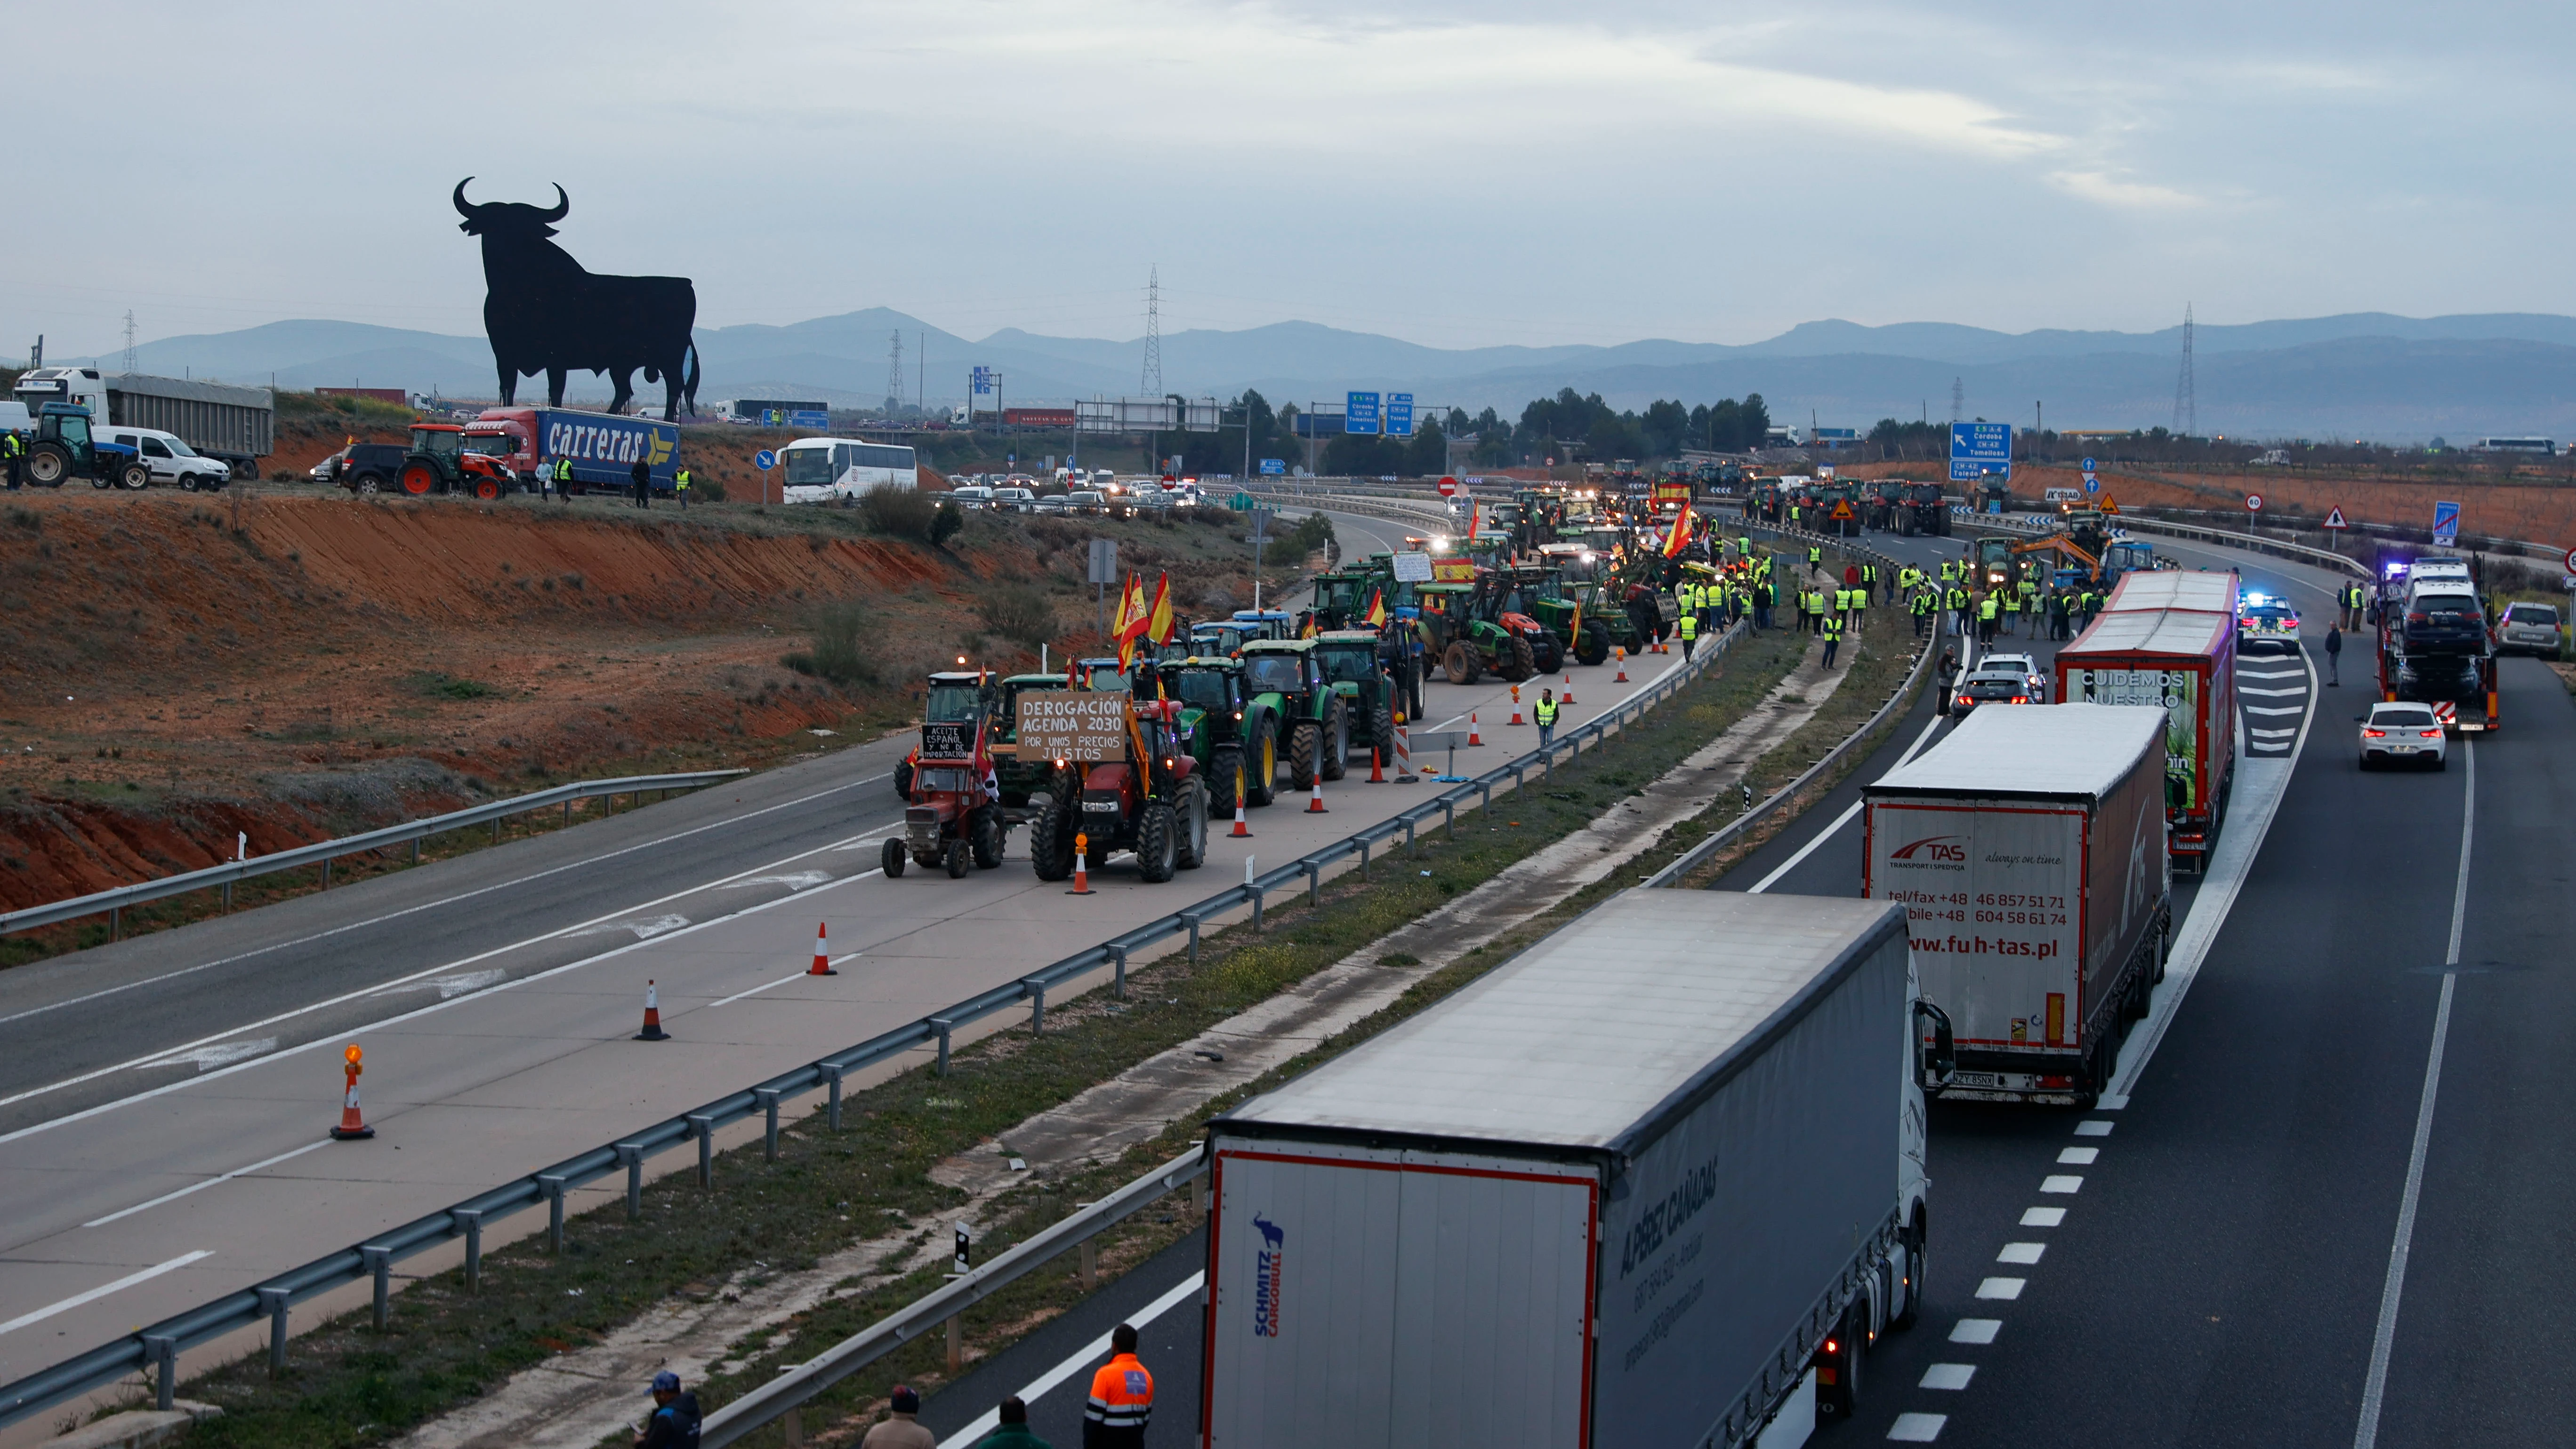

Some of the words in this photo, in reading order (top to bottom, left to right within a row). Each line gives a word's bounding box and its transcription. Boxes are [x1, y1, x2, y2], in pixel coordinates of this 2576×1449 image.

[549, 422, 644, 463] carreras
[2081, 672, 2184, 688] CUIDEMOS
[1023, 695, 1122, 716] DEROGACIÓN
[2085, 693, 2180, 708] NUESTRO
[931, 726, 958, 736] ACEITE
[1022, 716, 1079, 733] AGENDA
[1087, 716, 1122, 732] 2030
[926, 733, 962, 744] ESPAÑOL
[1025, 736, 1042, 747] POR
[1048, 736, 1070, 747] UNOS
[1078, 735, 1120, 749] PRECIOS
[1042, 747, 1102, 761] JUSTOS
[1926, 844, 1965, 861] TAS
[1985, 851, 2020, 869] always
[2022, 856, 2035, 865] on
[2036, 853, 2062, 865] time
[1890, 862, 1930, 870] TRANSPORT
[1888, 890, 1935, 904] tel/fax
[1939, 893, 1968, 905] +48
[1976, 893, 1995, 906] 46
[1998, 894, 2026, 907] 857
[2029, 895, 2045, 908] 51
[2048, 896, 2065, 909] 71
[1908, 908, 1932, 921] bile
[1936, 910, 1965, 922] +48
[1975, 910, 2004, 923] 604
[2007, 912, 2026, 924] 58
[2029, 913, 2046, 925] 61
[2050, 913, 2067, 926] 74
[1972, 1076, 1993, 1085] 85NX
[1255, 1250, 1271, 1337] SCHMITZ
[1268, 1252, 1282, 1338] CARGOBULL
